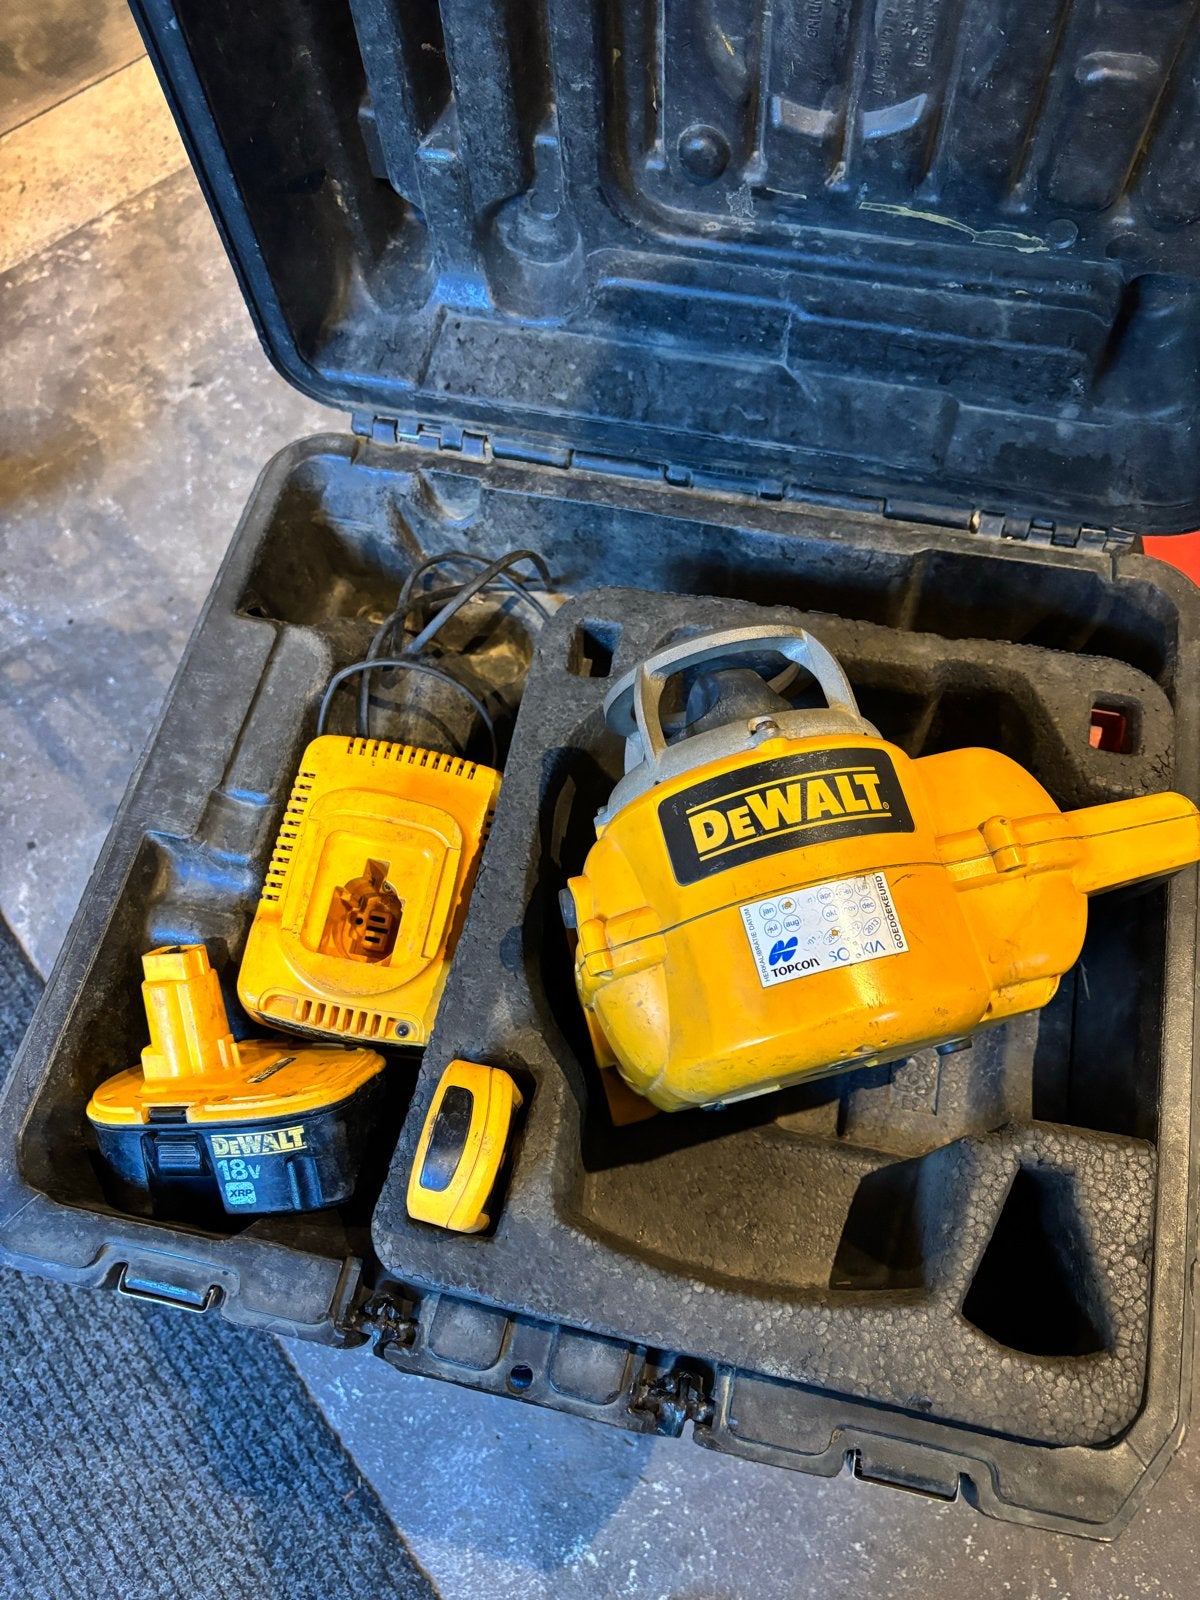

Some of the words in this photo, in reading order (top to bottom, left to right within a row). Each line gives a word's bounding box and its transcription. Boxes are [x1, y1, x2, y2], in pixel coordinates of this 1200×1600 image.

[820, 892, 831, 900] apr
[743, 908, 755, 931] DATUM
[763, 907, 774, 916] jan
[875, 875, 904, 948] GOEDGEKEURD
[786, 919, 800, 928] aug
[865, 918, 879, 934] 2013
[828, 940, 886, 962] SOKIA
[771, 957, 820, 978] TOPCON
[230, 1189, 252, 1198] XRP
